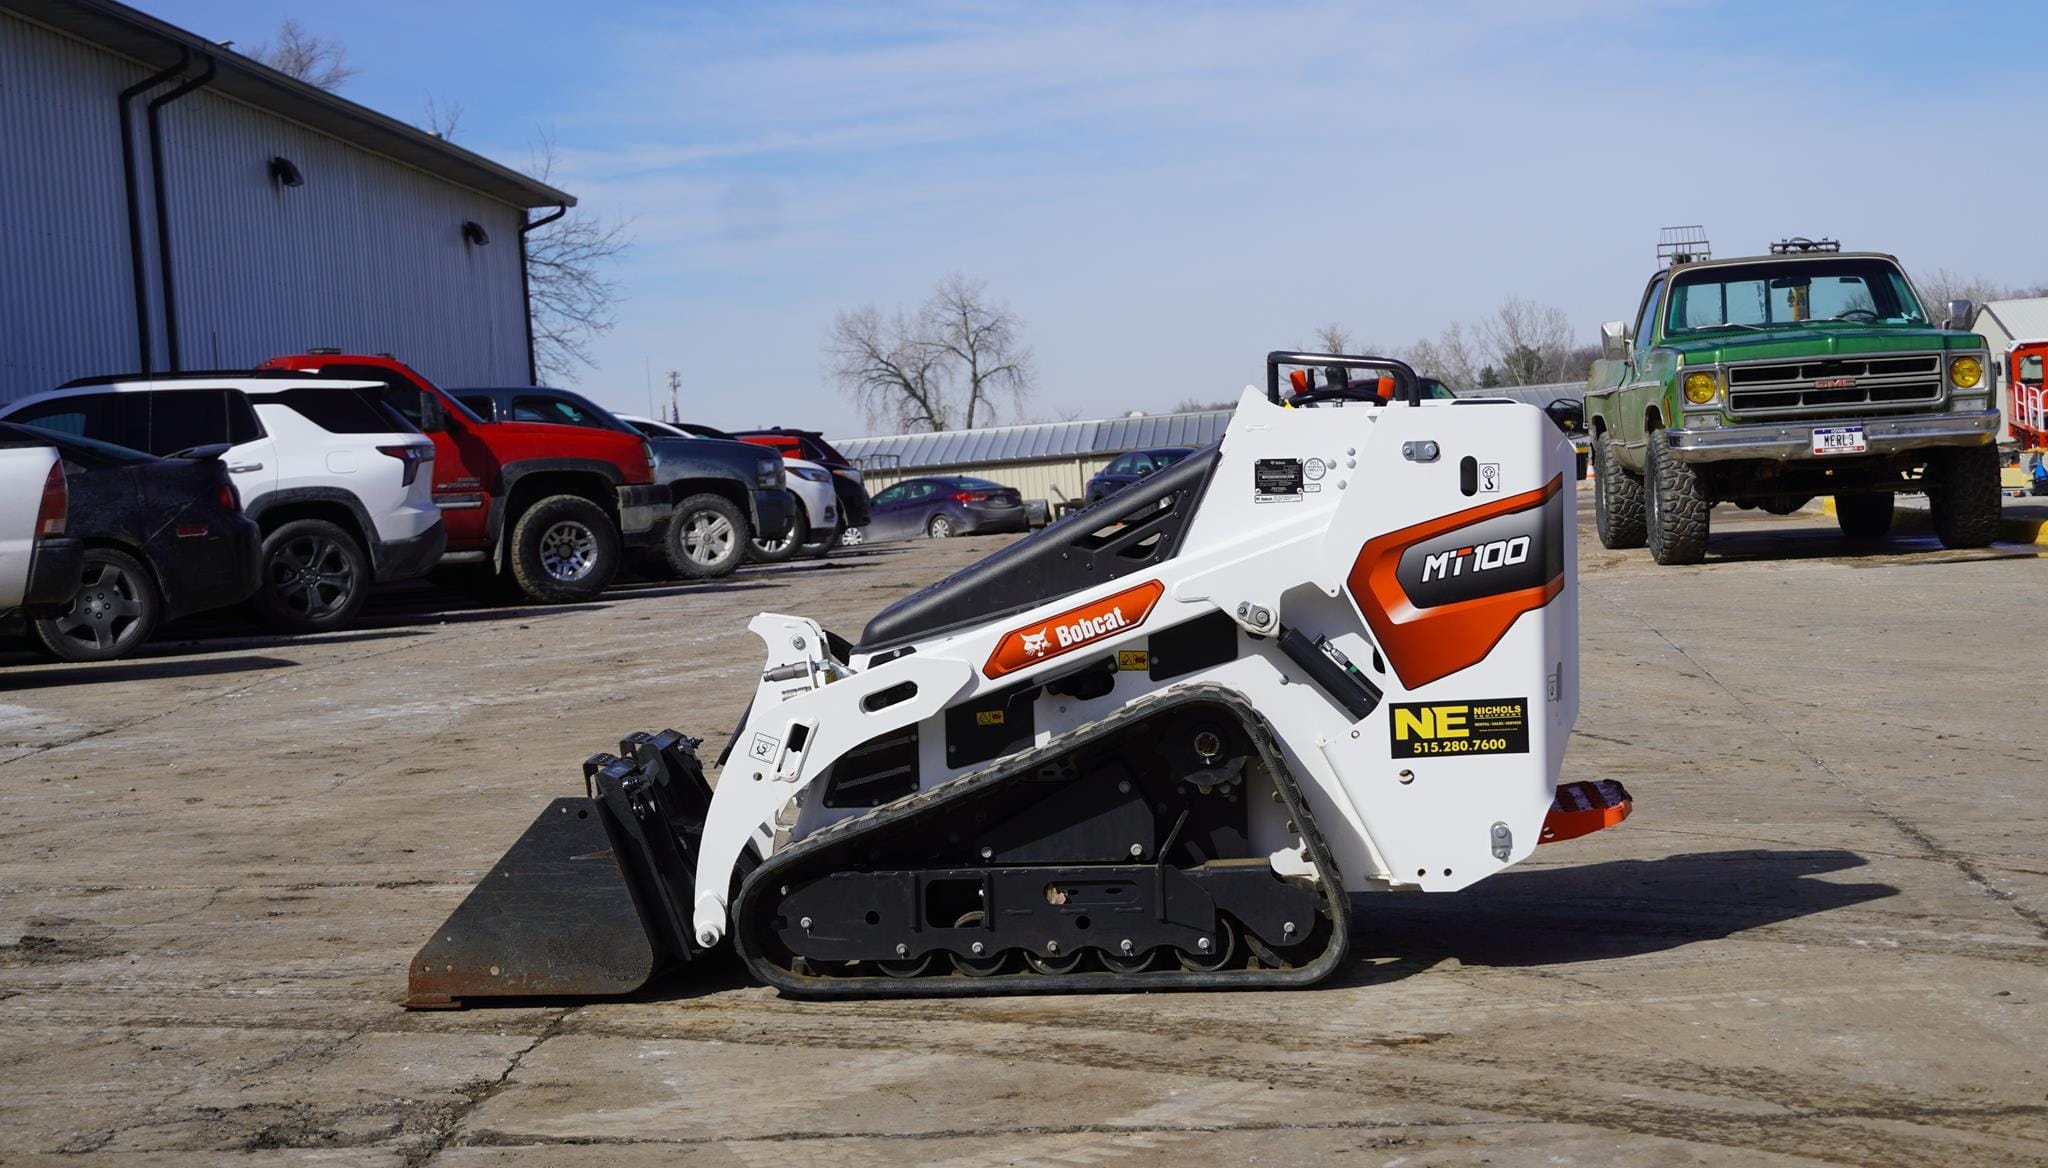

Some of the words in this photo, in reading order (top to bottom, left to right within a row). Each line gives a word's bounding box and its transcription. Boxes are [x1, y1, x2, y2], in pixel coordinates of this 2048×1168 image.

[1422, 536, 1530, 582] MT100
[1055, 607, 1125, 647] Bobcat
[1394, 706, 1470, 740] NE
[1474, 705, 1521, 715] NICHOLS
[1413, 739, 1506, 753] 515.280.7600
